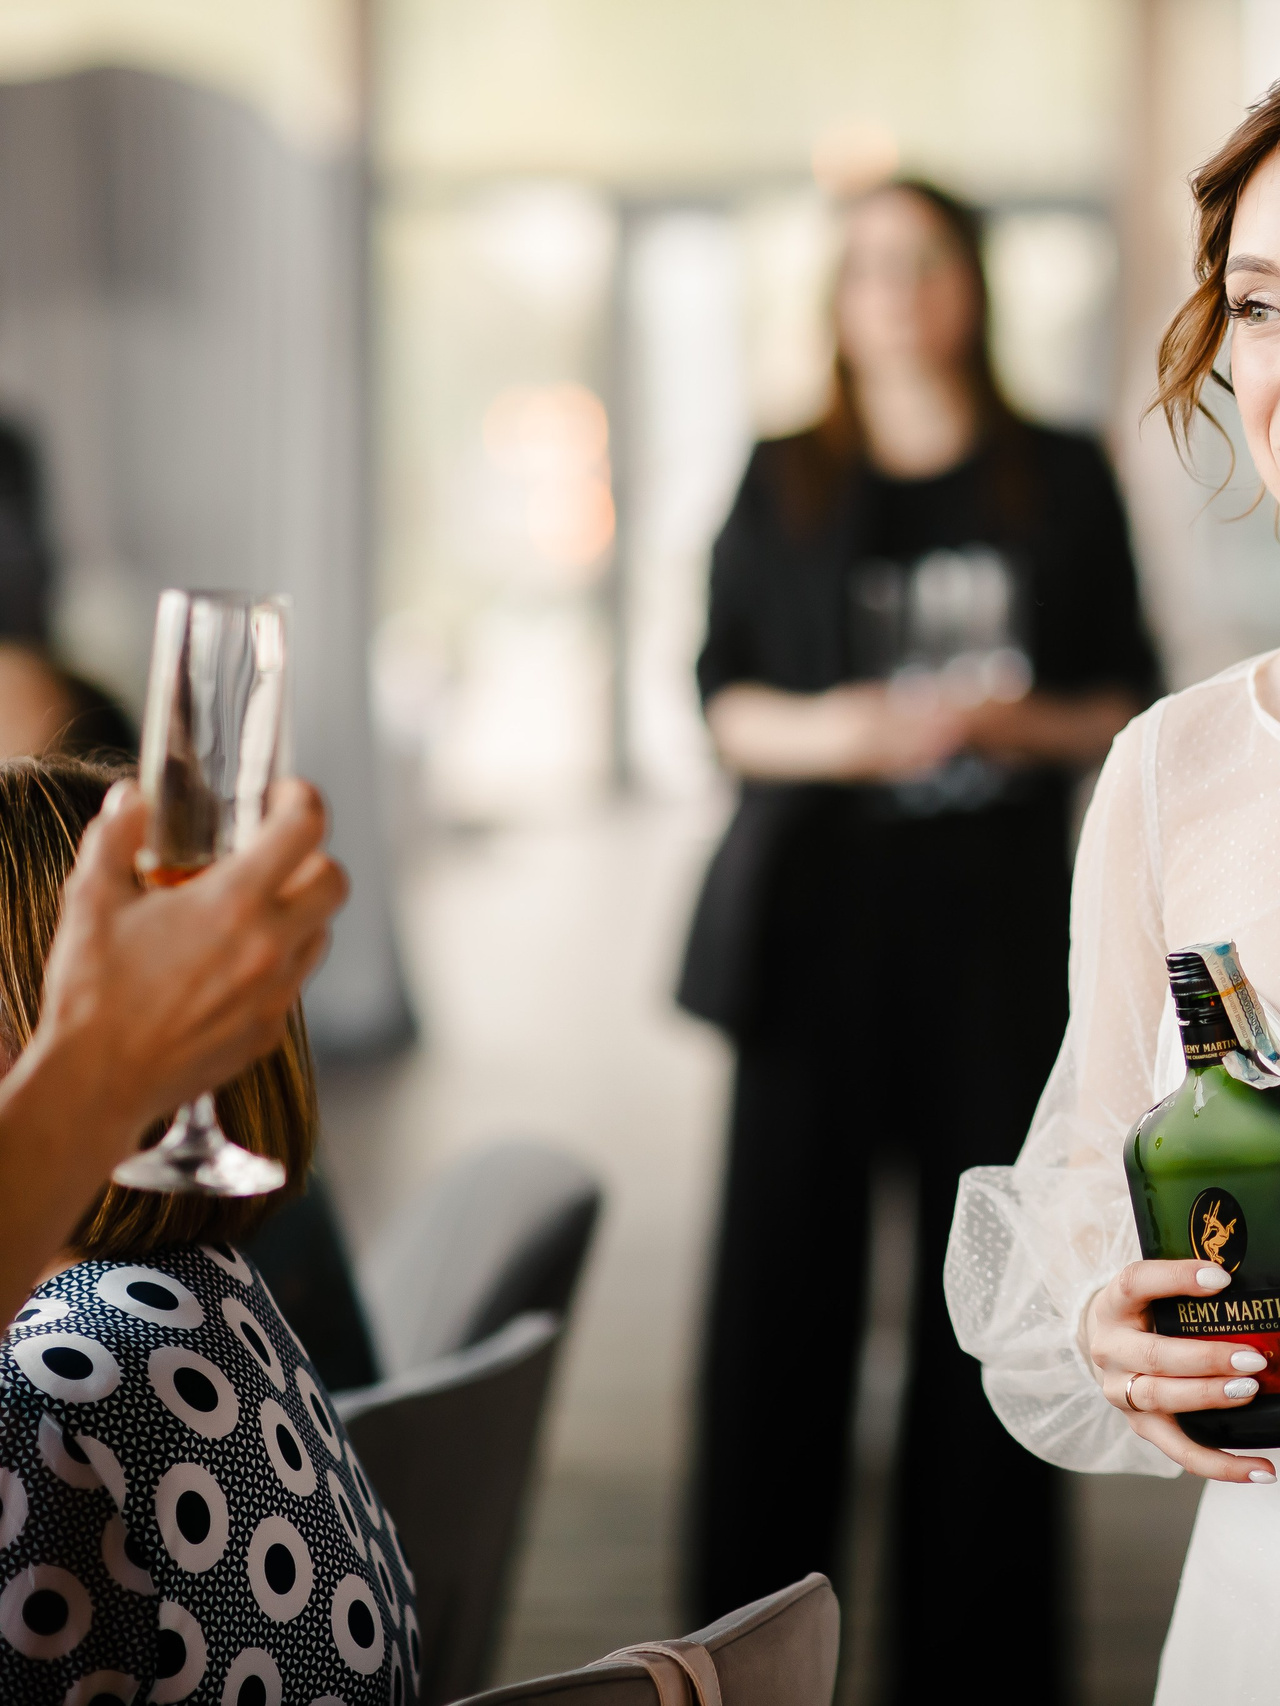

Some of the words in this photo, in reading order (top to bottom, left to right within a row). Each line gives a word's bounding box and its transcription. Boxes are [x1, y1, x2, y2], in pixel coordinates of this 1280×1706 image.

[1203, 1039, 1237, 1052] MARTIN
[1178, 1302, 1219, 1323] RÉMY
[1203, 1324, 1255, 1332] CHAMPAGNE
